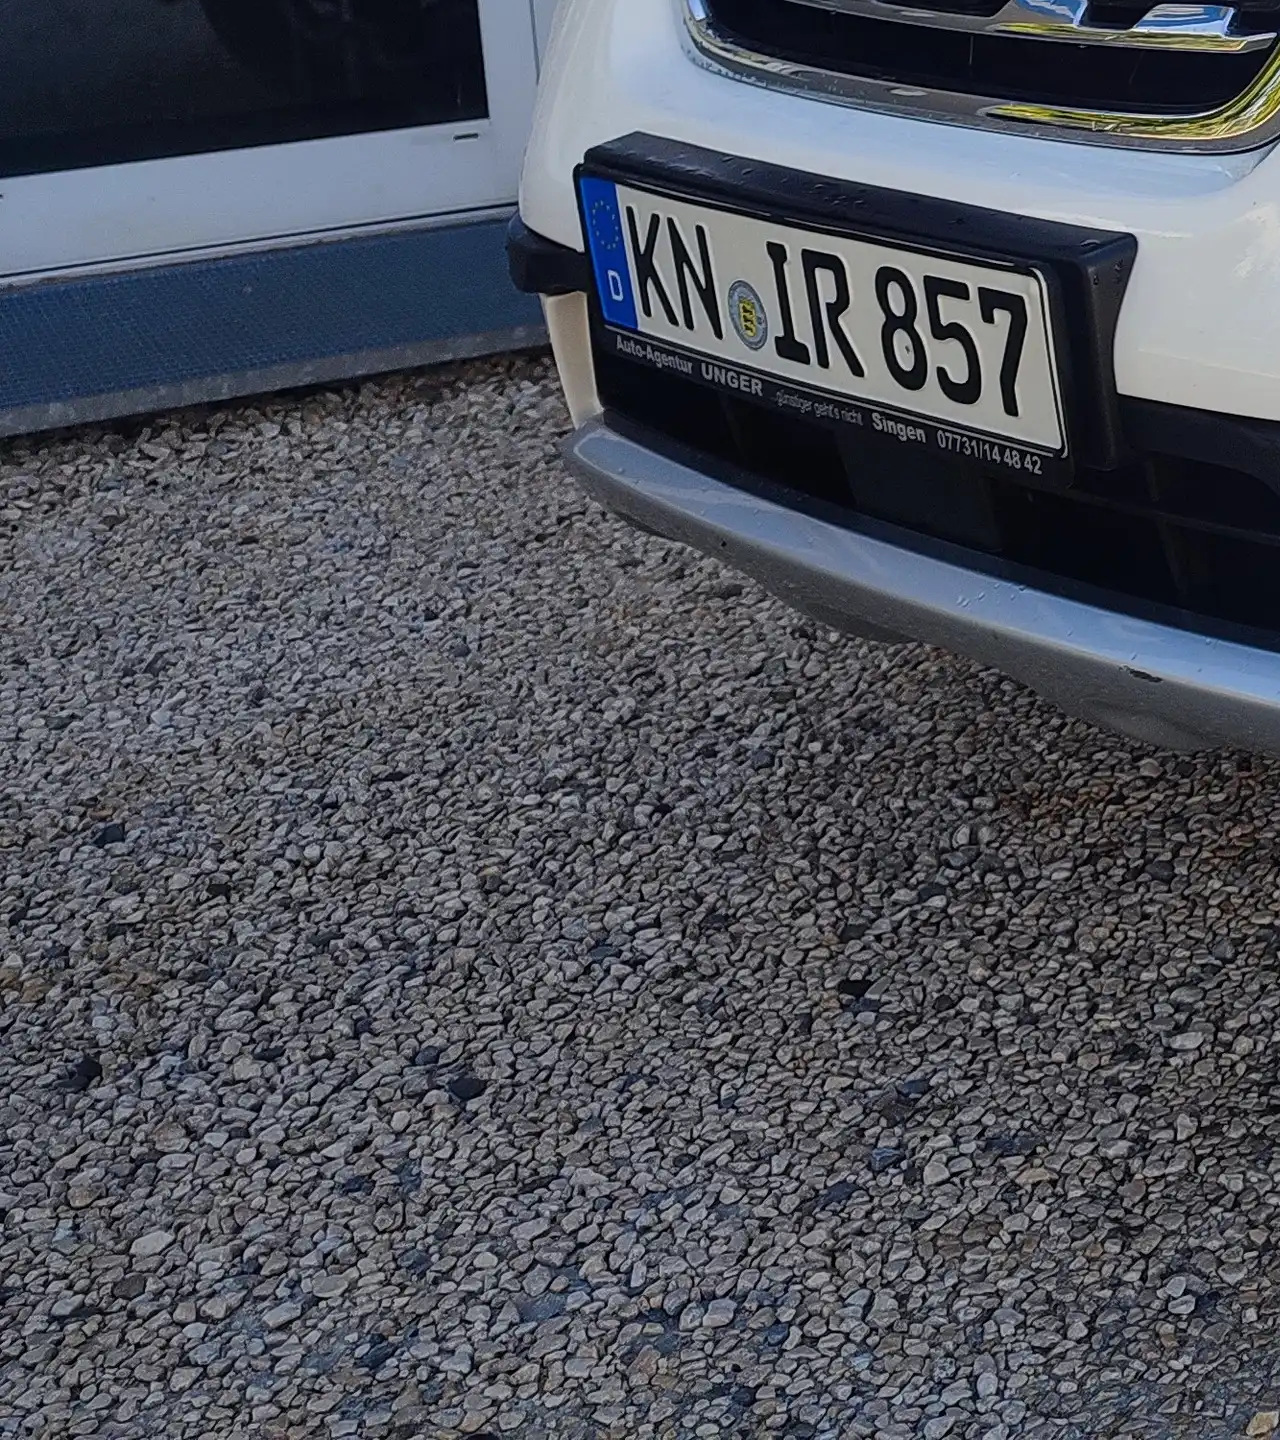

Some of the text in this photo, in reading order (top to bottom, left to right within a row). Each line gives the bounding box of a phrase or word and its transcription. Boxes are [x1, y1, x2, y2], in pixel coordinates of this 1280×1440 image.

[625, 205, 1029, 418] KN IR 857
[616, 334, 693, 374] Auto-Agentur
[701, 362, 764, 397] UNGER
[871, 412, 927, 443] Singen
[1003, 447, 1021, 469] 48
[1024, 455, 1043, 475] 42
